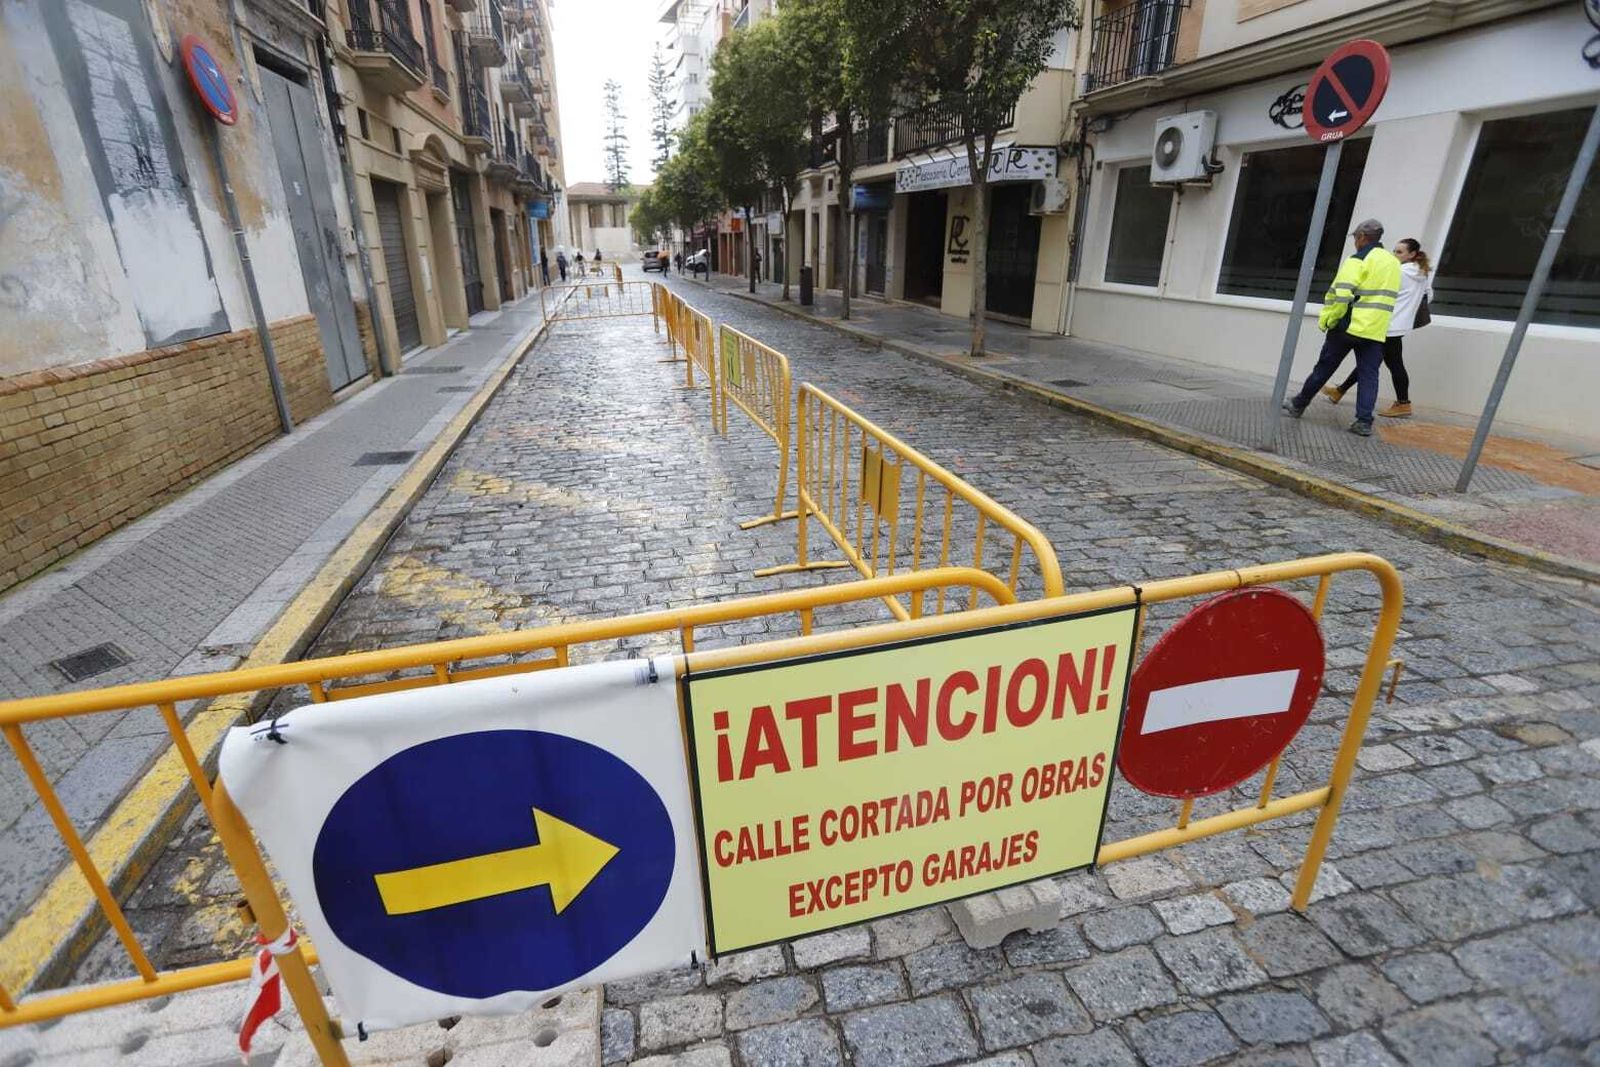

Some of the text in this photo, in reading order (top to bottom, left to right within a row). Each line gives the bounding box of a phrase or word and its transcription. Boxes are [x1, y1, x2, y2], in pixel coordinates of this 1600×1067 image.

[1321, 131, 1343, 140] GRUA
[713, 644, 1117, 783] ¡ATENCION!
[714, 752, 1106, 868] CALLE CORTADA POR OBRAS
[789, 830, 1039, 918] EXCEPTO GARAJES
